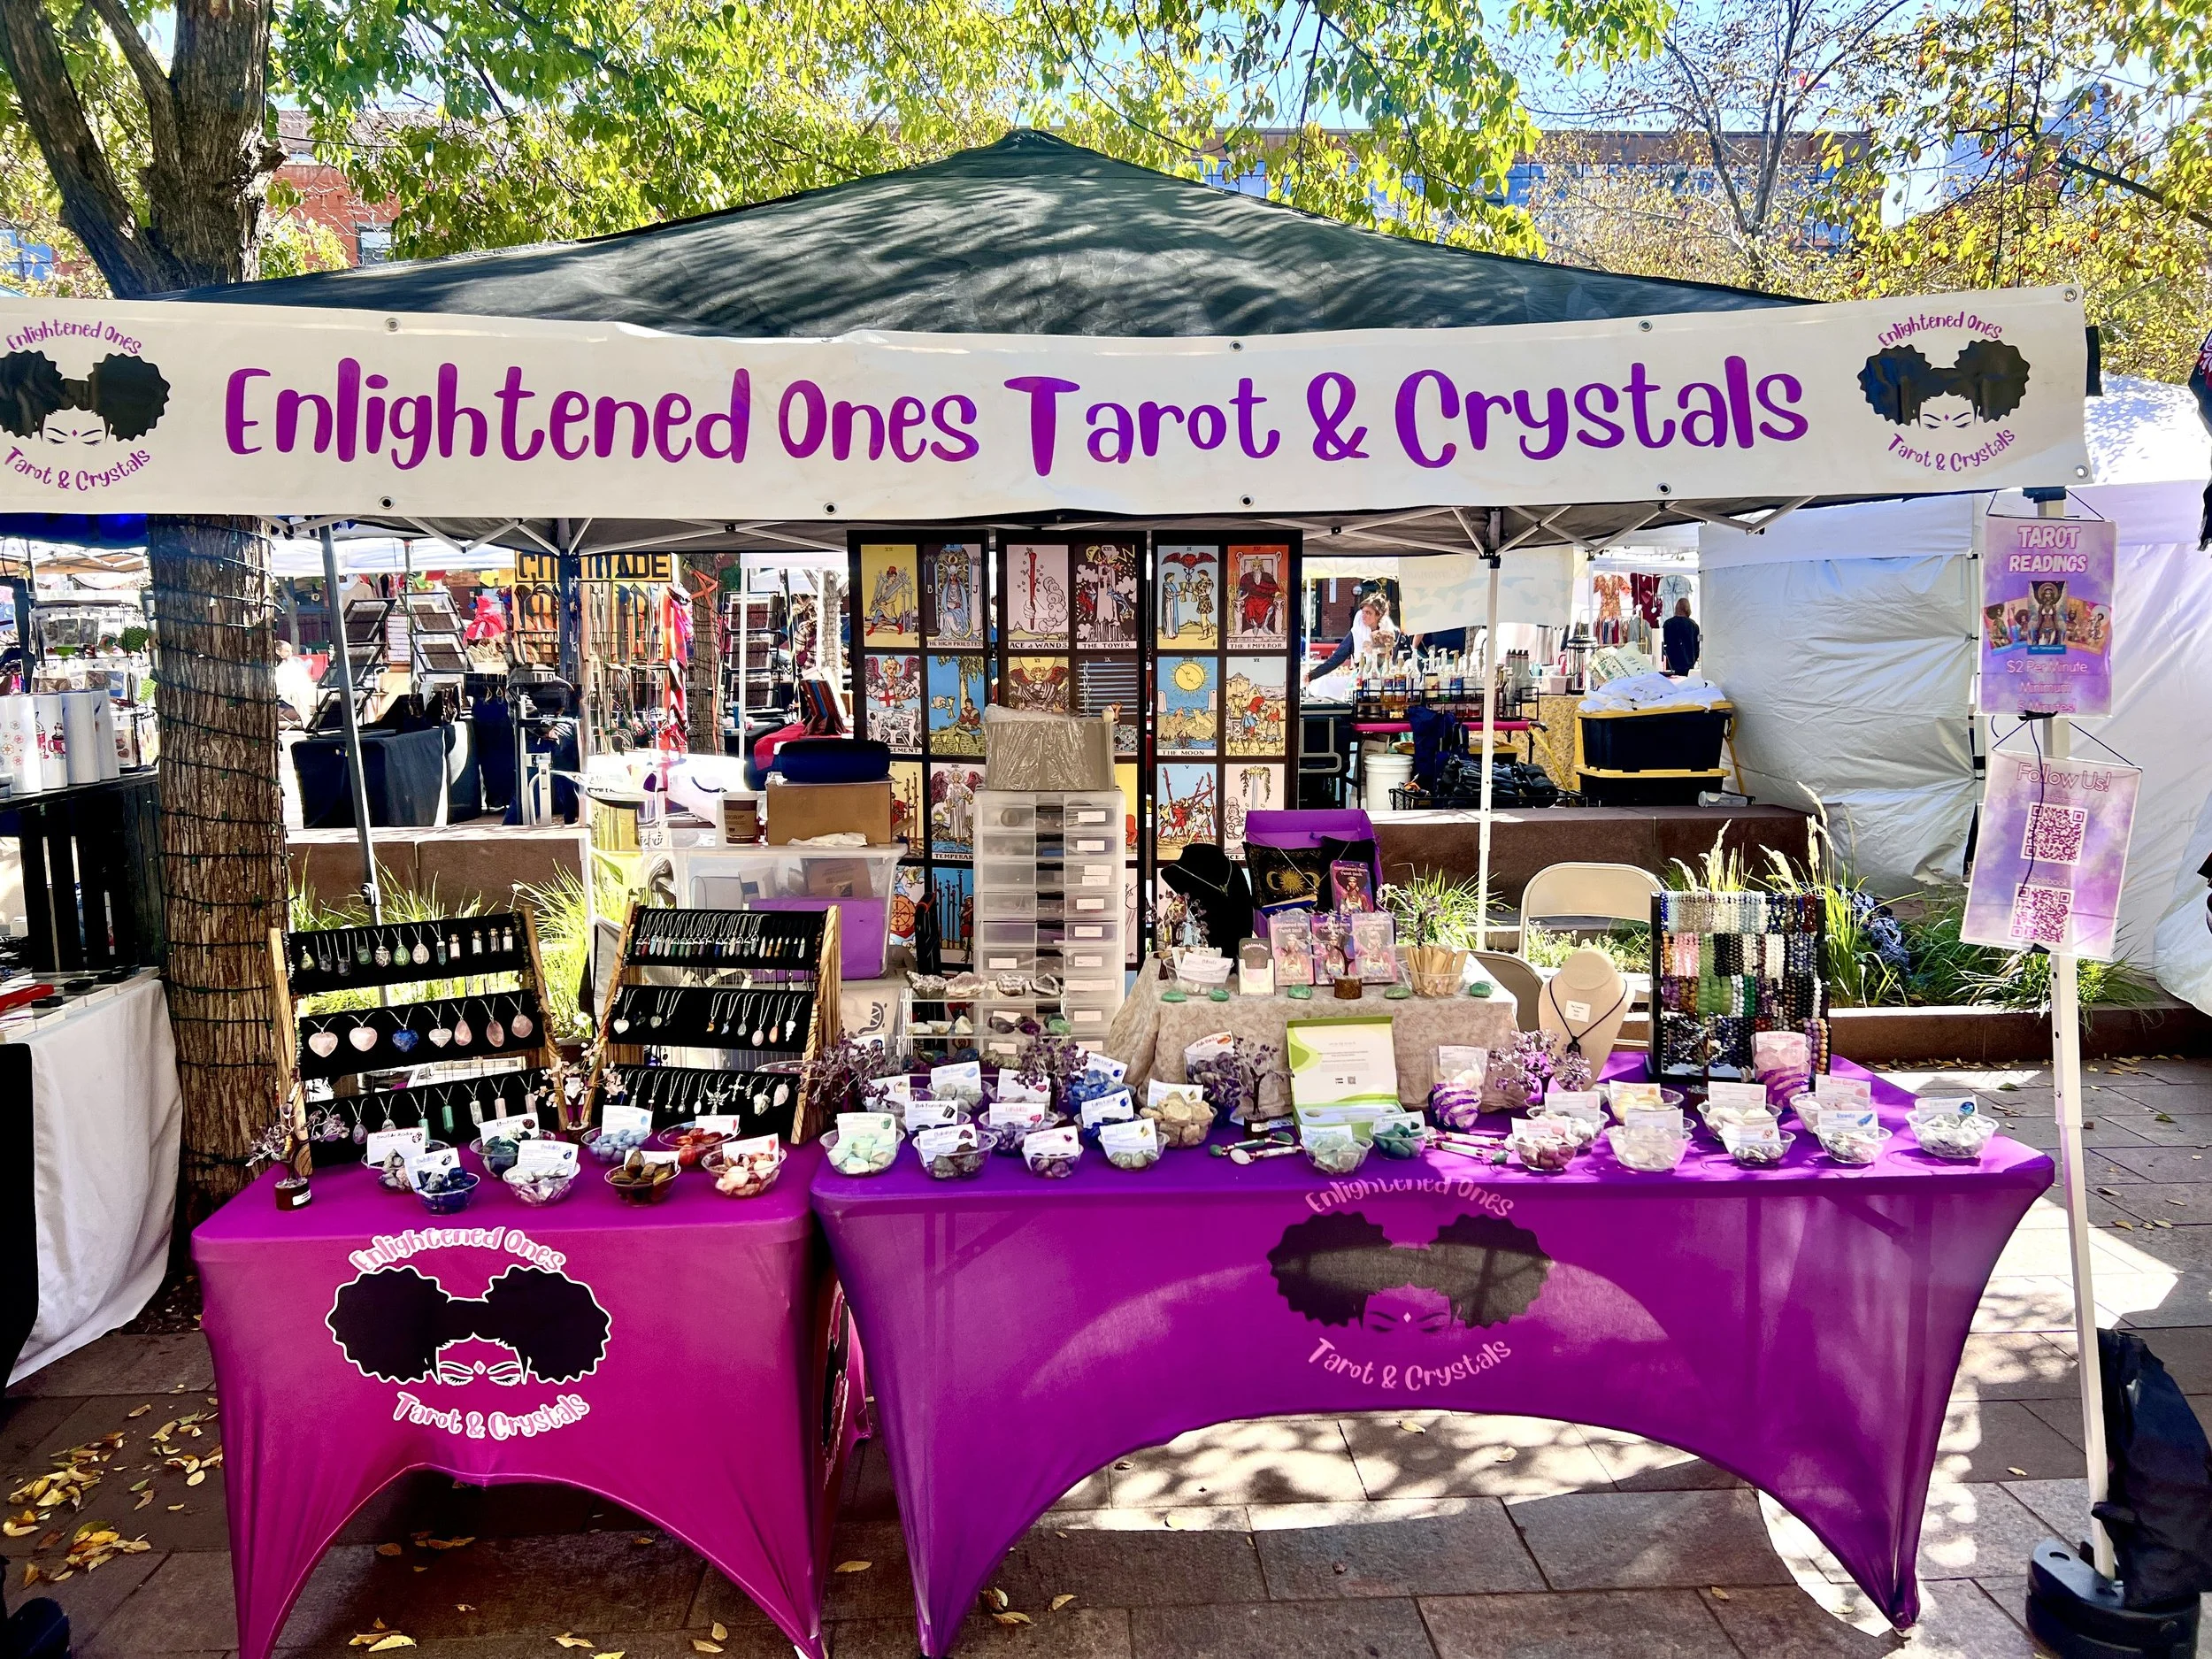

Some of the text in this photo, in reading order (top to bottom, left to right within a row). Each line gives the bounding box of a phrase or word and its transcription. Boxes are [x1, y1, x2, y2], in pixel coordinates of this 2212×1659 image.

[5, 319, 142, 355] Enlightened Ones
[1878, 311, 2002, 347] Enlightened Ones
[225, 355, 1808, 476] Enlightened Ones Tarot & Crystals
[4, 445, 150, 491] Tarot & Crystals
[1887, 428, 2015, 472] Tarot & Crystals
[2017, 526, 2081, 549] TAROT
[2008, 555, 2087, 573] READINGS
[2081, 770, 2113, 793] Us!
[1304, 1178, 1515, 1217] Enlightened Ones
[349, 1226, 566, 1272] Enlightened Ones
[1308, 1337, 1512, 1392] Tarot & Crystals
[392, 1392, 591, 1441] Tarot & Crystals
